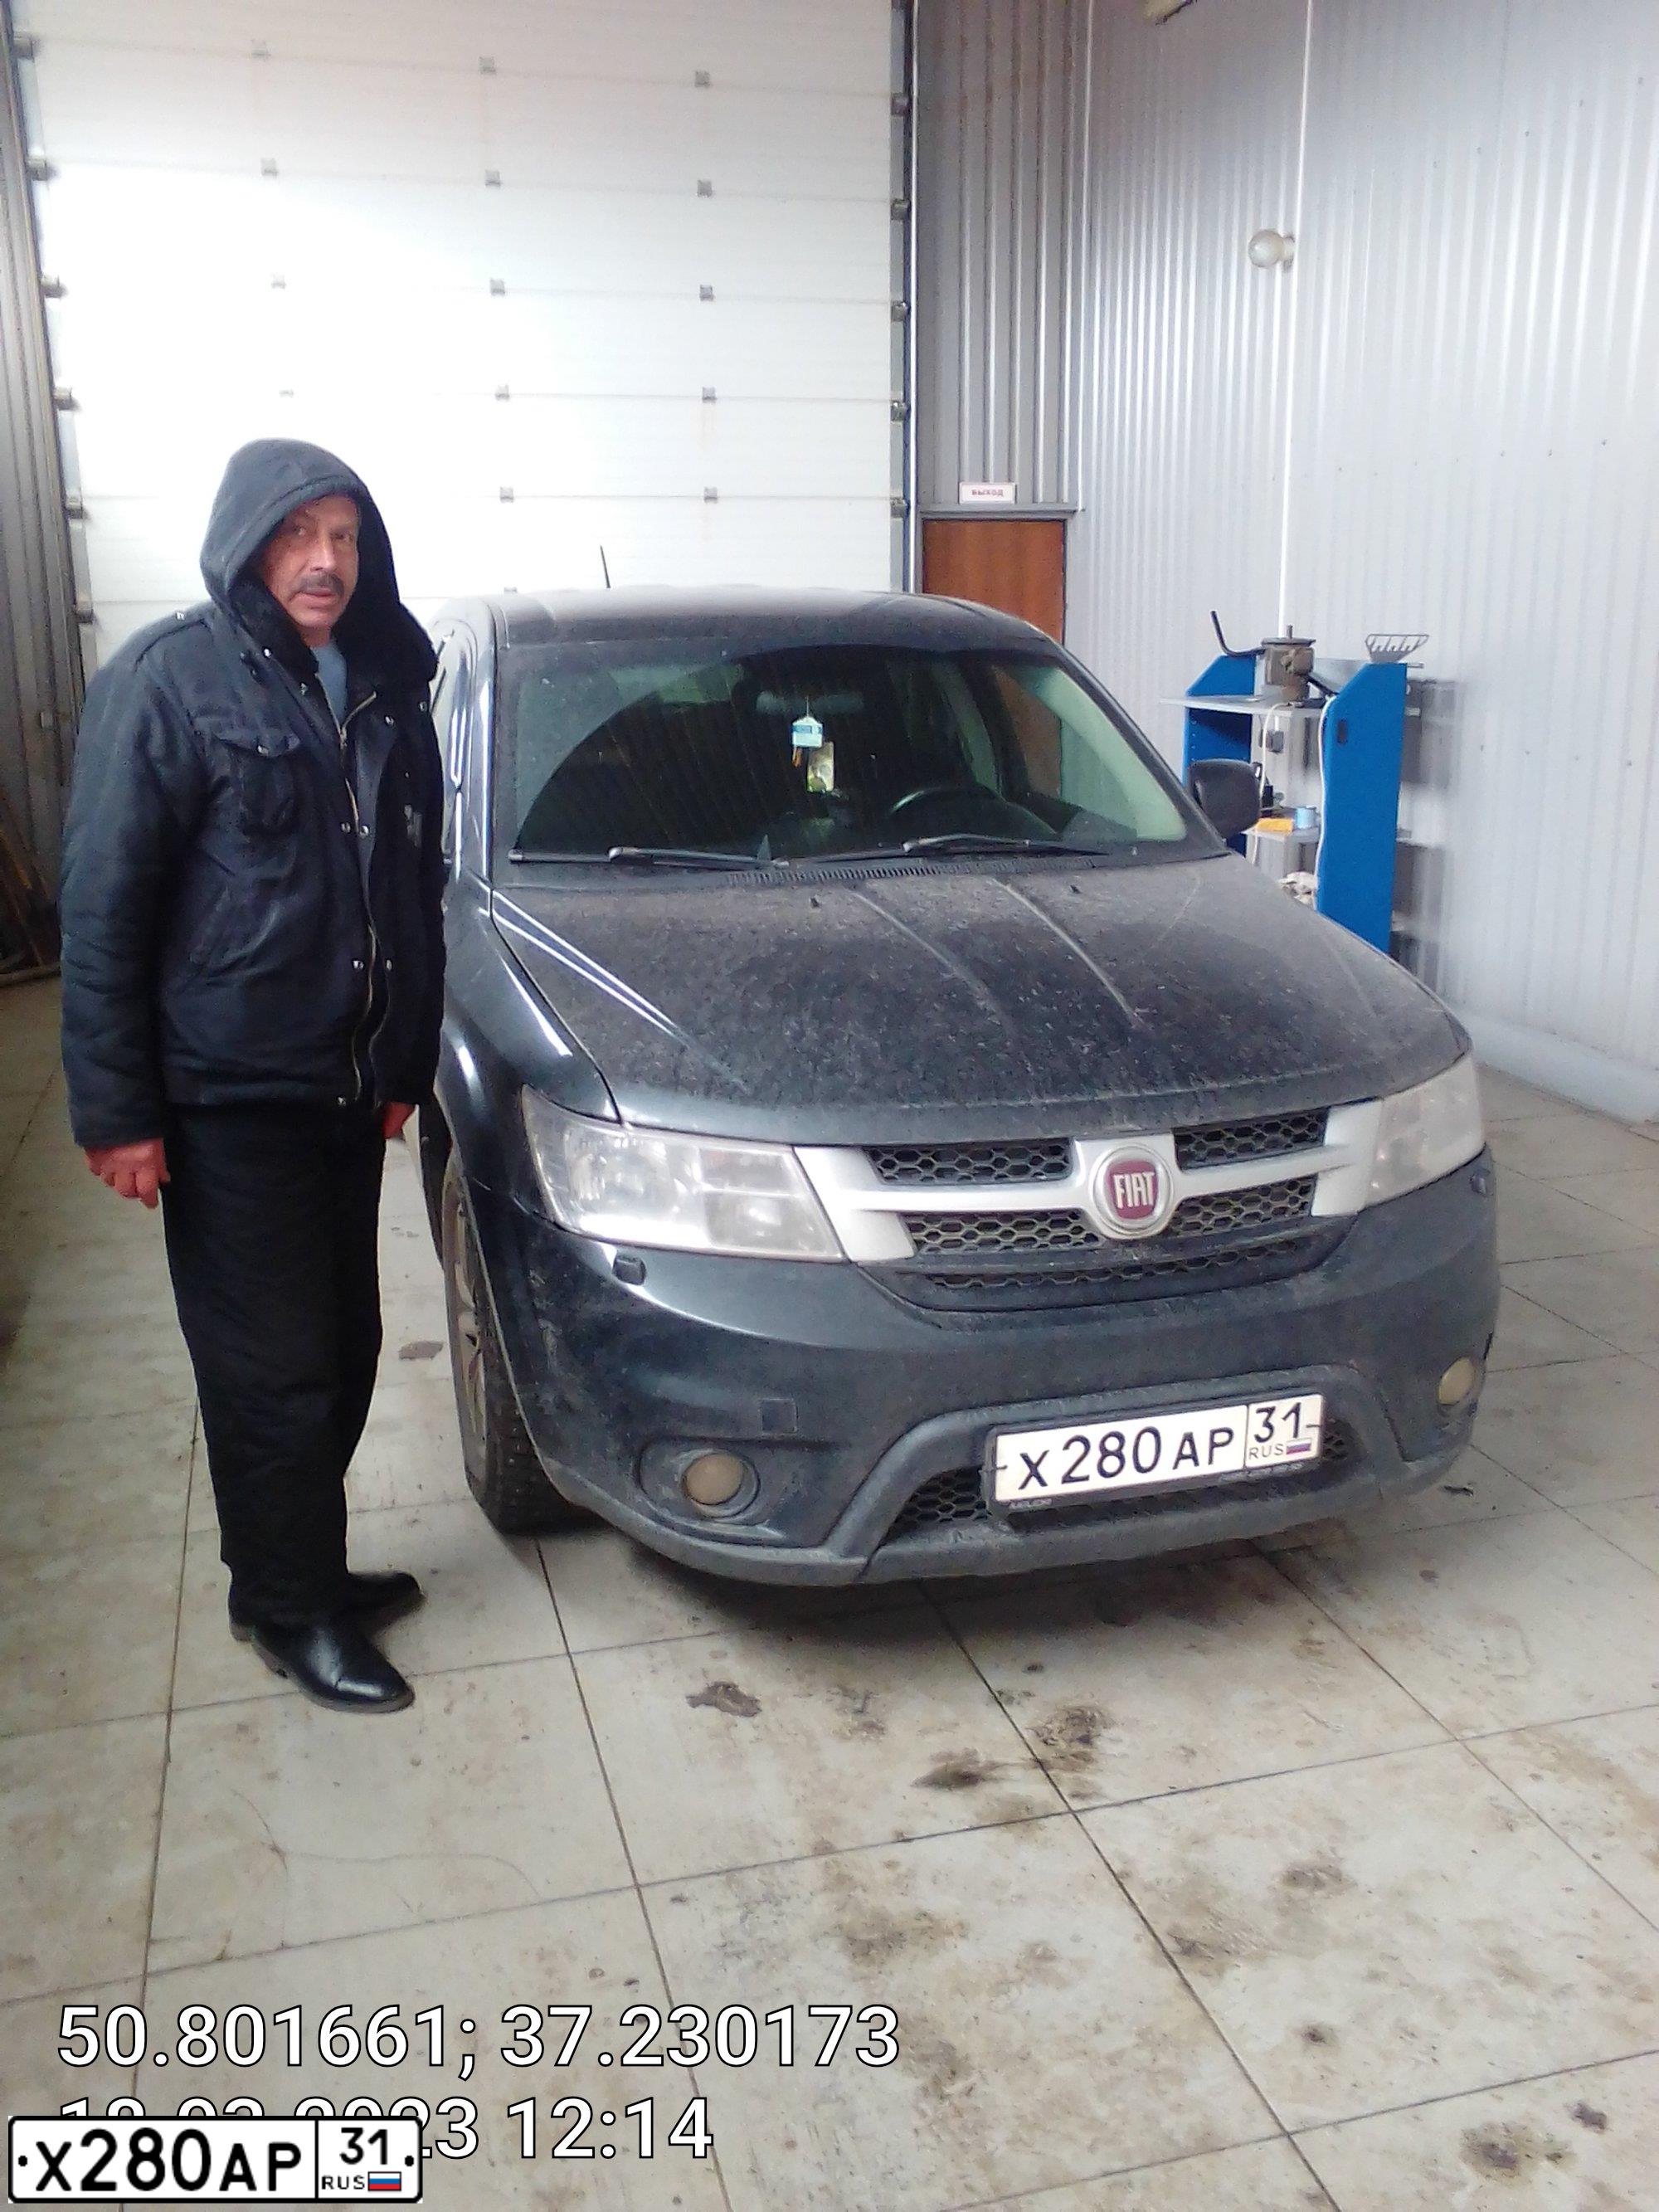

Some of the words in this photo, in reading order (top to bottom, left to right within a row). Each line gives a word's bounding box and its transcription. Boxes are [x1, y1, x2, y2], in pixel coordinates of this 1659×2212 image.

[971, 489, 1004, 497] ВЫХОД
[1112, 1172, 1155, 1209] FIAT
[1254, 1402, 1302, 1444] 31
[1248, 1443, 1284, 1459] RUS
